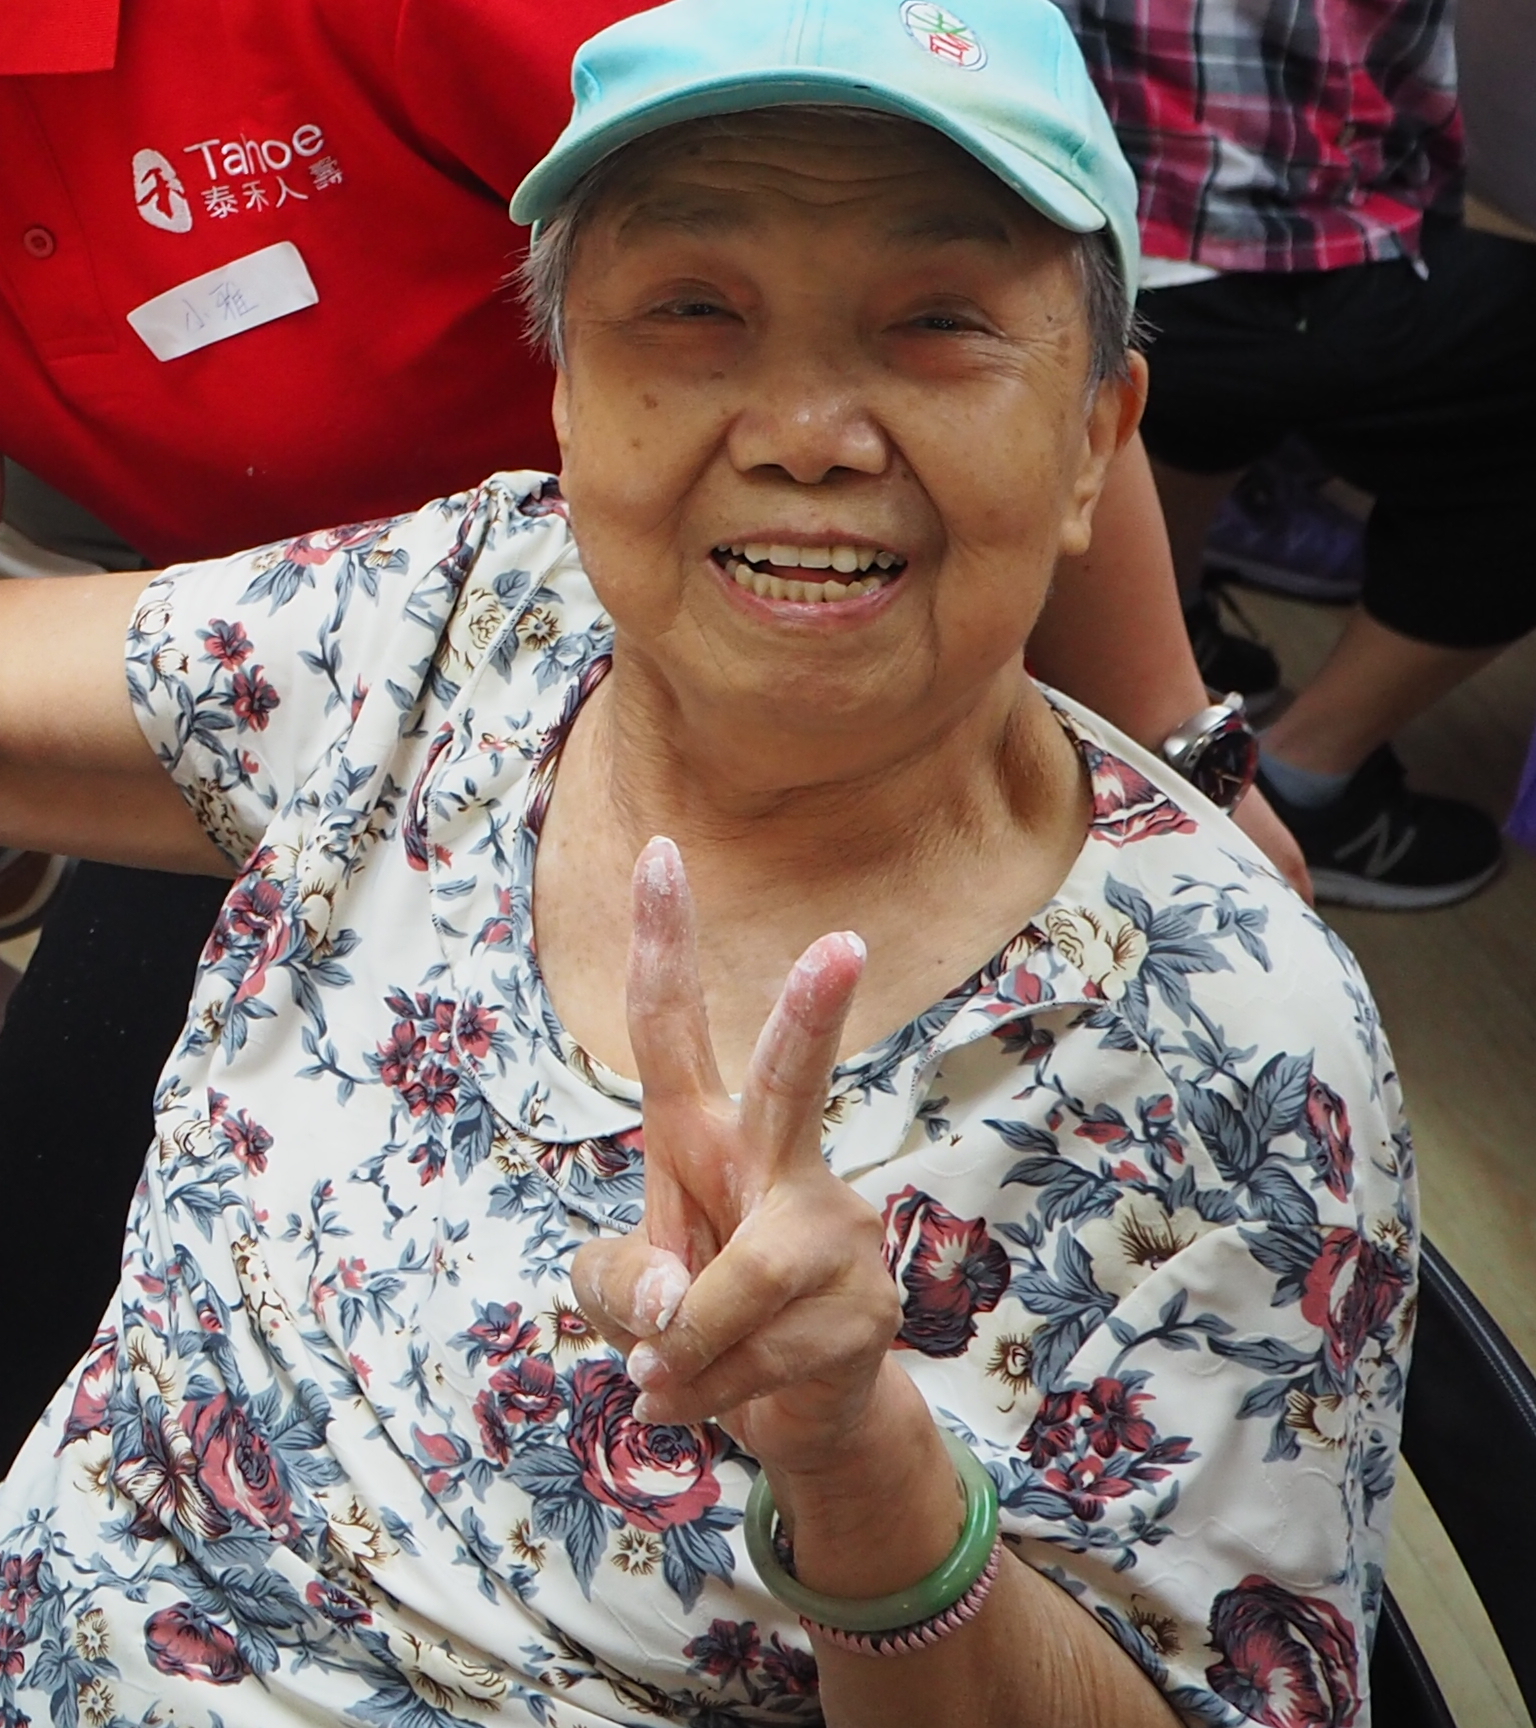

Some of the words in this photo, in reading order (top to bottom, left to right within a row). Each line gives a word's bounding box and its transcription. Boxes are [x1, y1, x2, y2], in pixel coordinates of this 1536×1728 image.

[183, 123, 325, 181] Tahoe
[200, 155, 344, 220] 泰禾人壽
